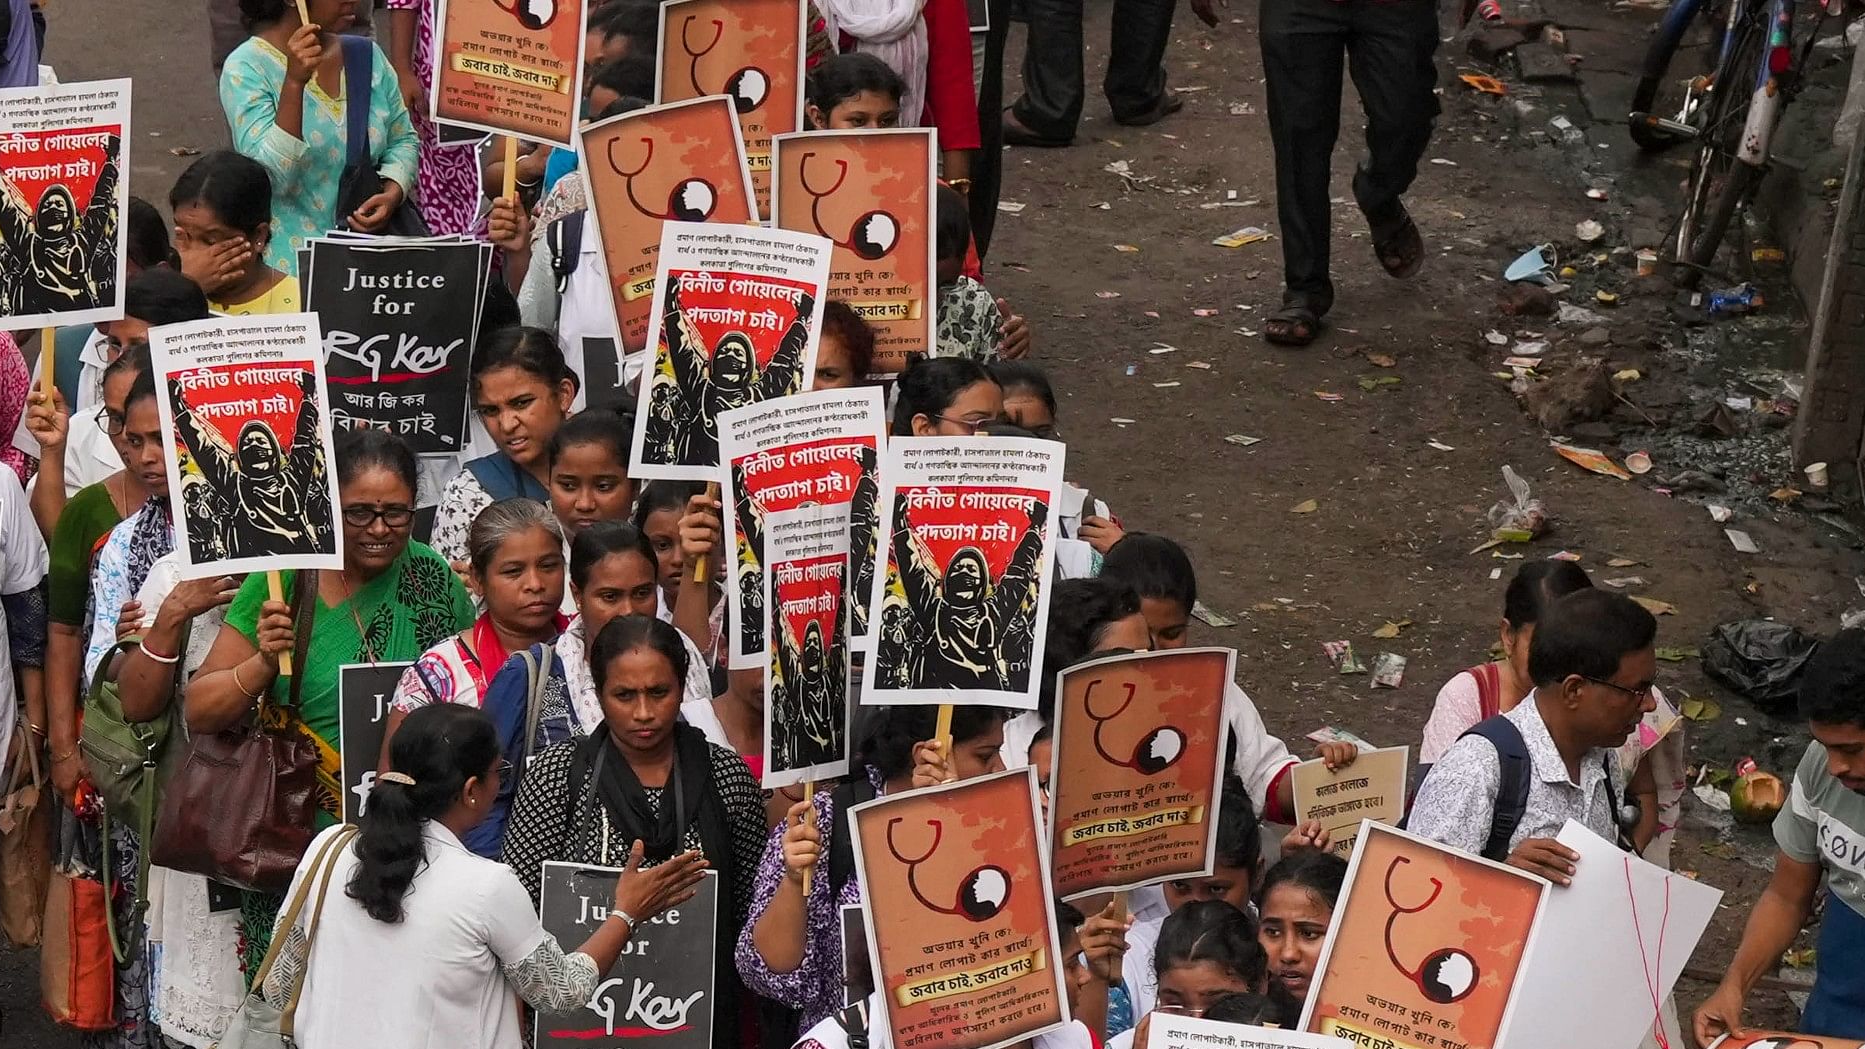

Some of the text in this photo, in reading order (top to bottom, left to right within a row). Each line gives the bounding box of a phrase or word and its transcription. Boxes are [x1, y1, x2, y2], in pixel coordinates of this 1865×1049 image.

[44, 131, 111, 152] গোয়েলের
[3, 157, 96, 183] পদত্যাগ চাই।
[343, 267, 445, 292] Justice
[677, 271, 805, 307] বিনীত গোয়েলের
[372, 293, 416, 315] for
[684, 306, 784, 331] পদত্যাগ চাই।
[390, 331, 465, 374] Kar
[178, 367, 304, 390] বিনীত গোয়েলের
[195, 392, 295, 421] পদত্যাগ চাই।
[345, 391, 426, 410] আর জি কর
[397, 410, 436, 435] চাই
[740, 443, 864, 476] বিনীত গোয়েলের
[753, 470, 851, 507] পদত্যাগ চাই।
[905, 486, 1037, 515] বিনীত গোয়েলের
[914, 519, 1017, 542] পদত্যাগ চাই।
[1072, 823, 1105, 839] জবাব
[1106, 818, 1130, 833] চাই,
[1132, 813, 1164, 830] জবাব
[908, 980, 946, 998] জবাব
[946, 973, 973, 990] চাই,
[974, 965, 1009, 984] জবাব
[625, 976, 704, 1031] Kar
[1167, 1030, 1189, 1040] প্রমাণ
[1189, 1033, 1238, 1048] লোপাটকারী,
[1334, 1024, 1372, 1048] জবাব
